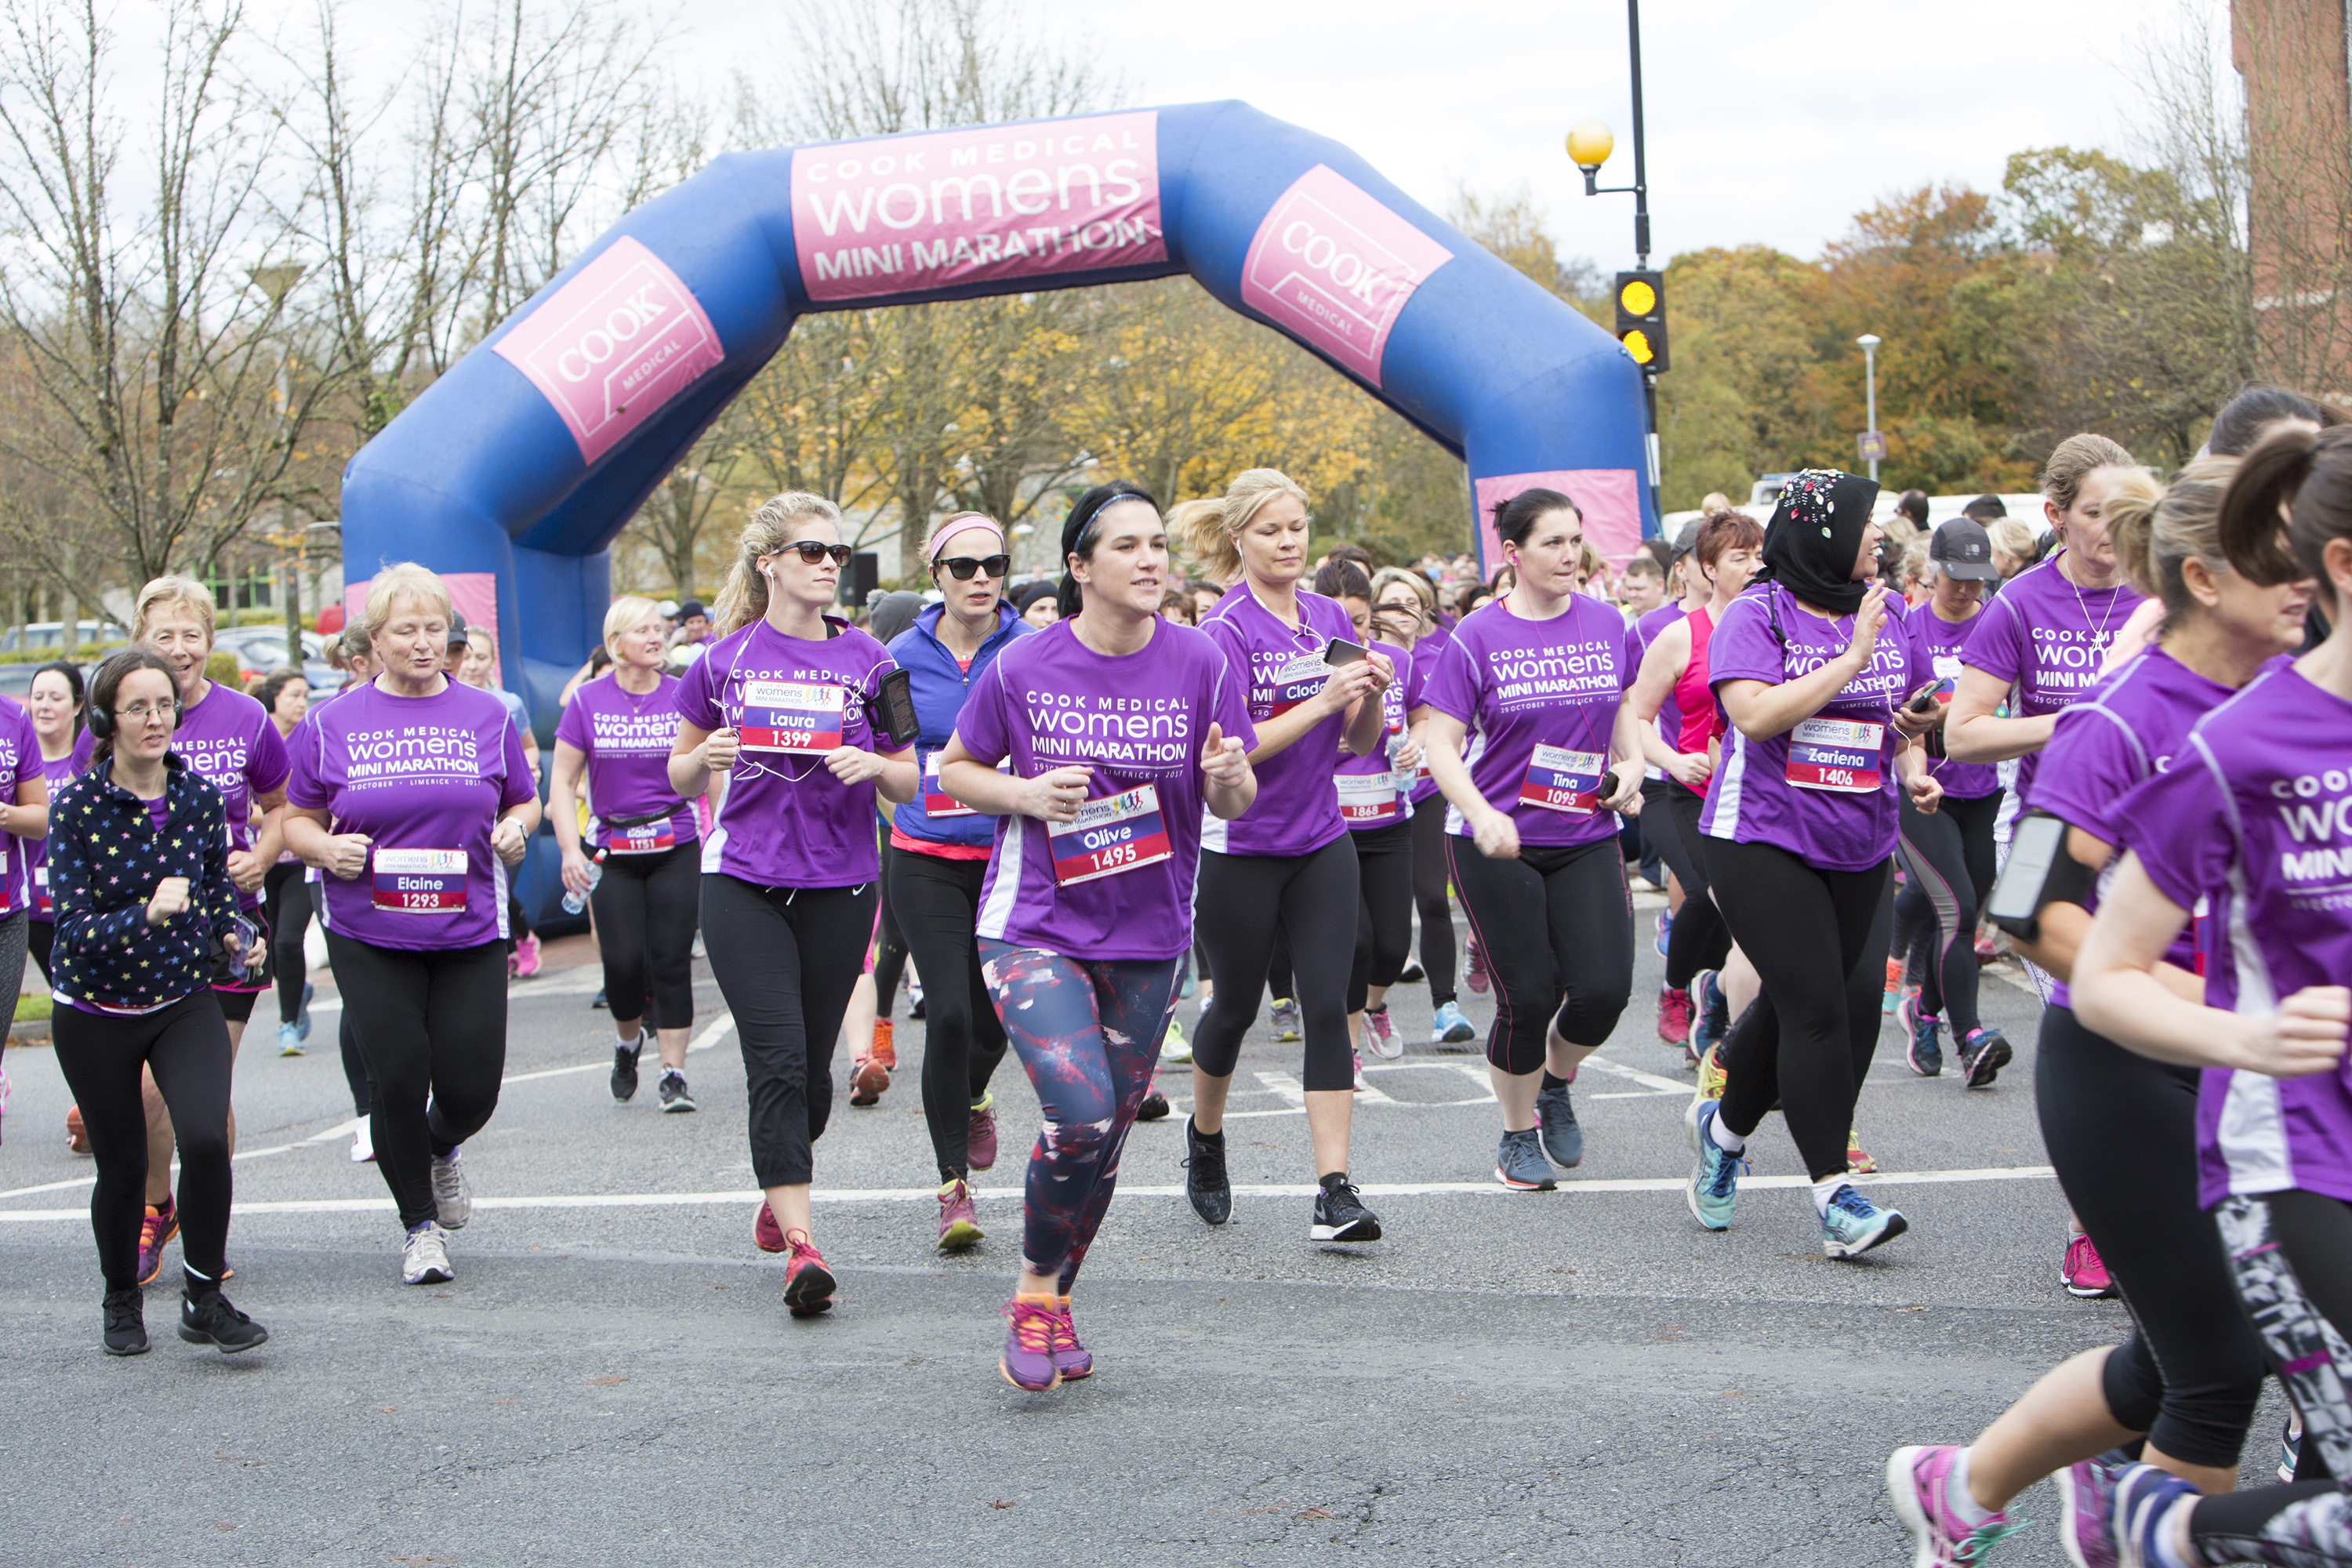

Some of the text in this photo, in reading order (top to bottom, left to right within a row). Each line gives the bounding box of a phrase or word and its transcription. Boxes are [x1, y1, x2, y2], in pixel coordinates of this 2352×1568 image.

[807, 130, 1139, 183] COOK MEDICAL
[808, 159, 1142, 237] womens
[813, 216, 1149, 281] MINI MARATHON
[1282, 220, 1386, 307] COOK
[1297, 291, 1353, 336] MEDICAL
[557, 278, 666, 383] COOK
[622, 339, 681, 390] MEDICAL
[2031, 627, 2087, 642] COOK
[1490, 641, 1611, 662] COOK MEDICAL
[1784, 638, 1897, 654] COOK MCAL
[2034, 644, 2112, 667] wom
[1251, 651, 1298, 662] COOK
[1285, 659, 1322, 673] womens
[1784, 650, 1904, 676] wons
[1493, 652, 1614, 682] womens
[732, 669, 867, 695] COOK MEDICAL
[1497, 674, 1618, 699] MINI MARATHON
[1840, 673, 1906, 694] RATHON
[2036, 670, 2074, 687] MINI
[757, 688, 802, 698] womens
[1026, 691, 1189, 712] COOK MEDICAL
[593, 711, 681, 724] COOK MEDICA
[770, 711, 815, 728] Laura
[1028, 708, 1189, 739] womens
[347, 726, 477, 742] COOK MEDICAL
[772, 730, 811, 747] 1399
[1804, 724, 1850, 735] womens
[171, 736, 246, 752] MEDICAL
[347, 737, 477, 761] womens
[593, 736, 677, 748] MINI MARATH
[1032, 735, 1187, 761] MINI MARATHON
[1542, 750, 1577, 763] womens
[1808, 747, 1865, 767] Zariena
[347, 757, 480, 779] MINI MARATHON
[1103, 768, 1183, 779] LIMERICK 2017
[1818, 768, 1853, 786] 1406
[1553, 773, 1578, 789] Tina
[2270, 768, 2352, 799] COO
[1083, 800, 1109, 808] EDICAL
[1547, 789, 1577, 806] 1095
[1352, 805, 1378, 817] 1868
[1083, 826, 1132, 849] Olive
[1091, 843, 1137, 870] 1495
[2282, 845, 2352, 881] MIN
[397, 877, 444, 891] Elaine
[402, 893, 439, 908] 1293
